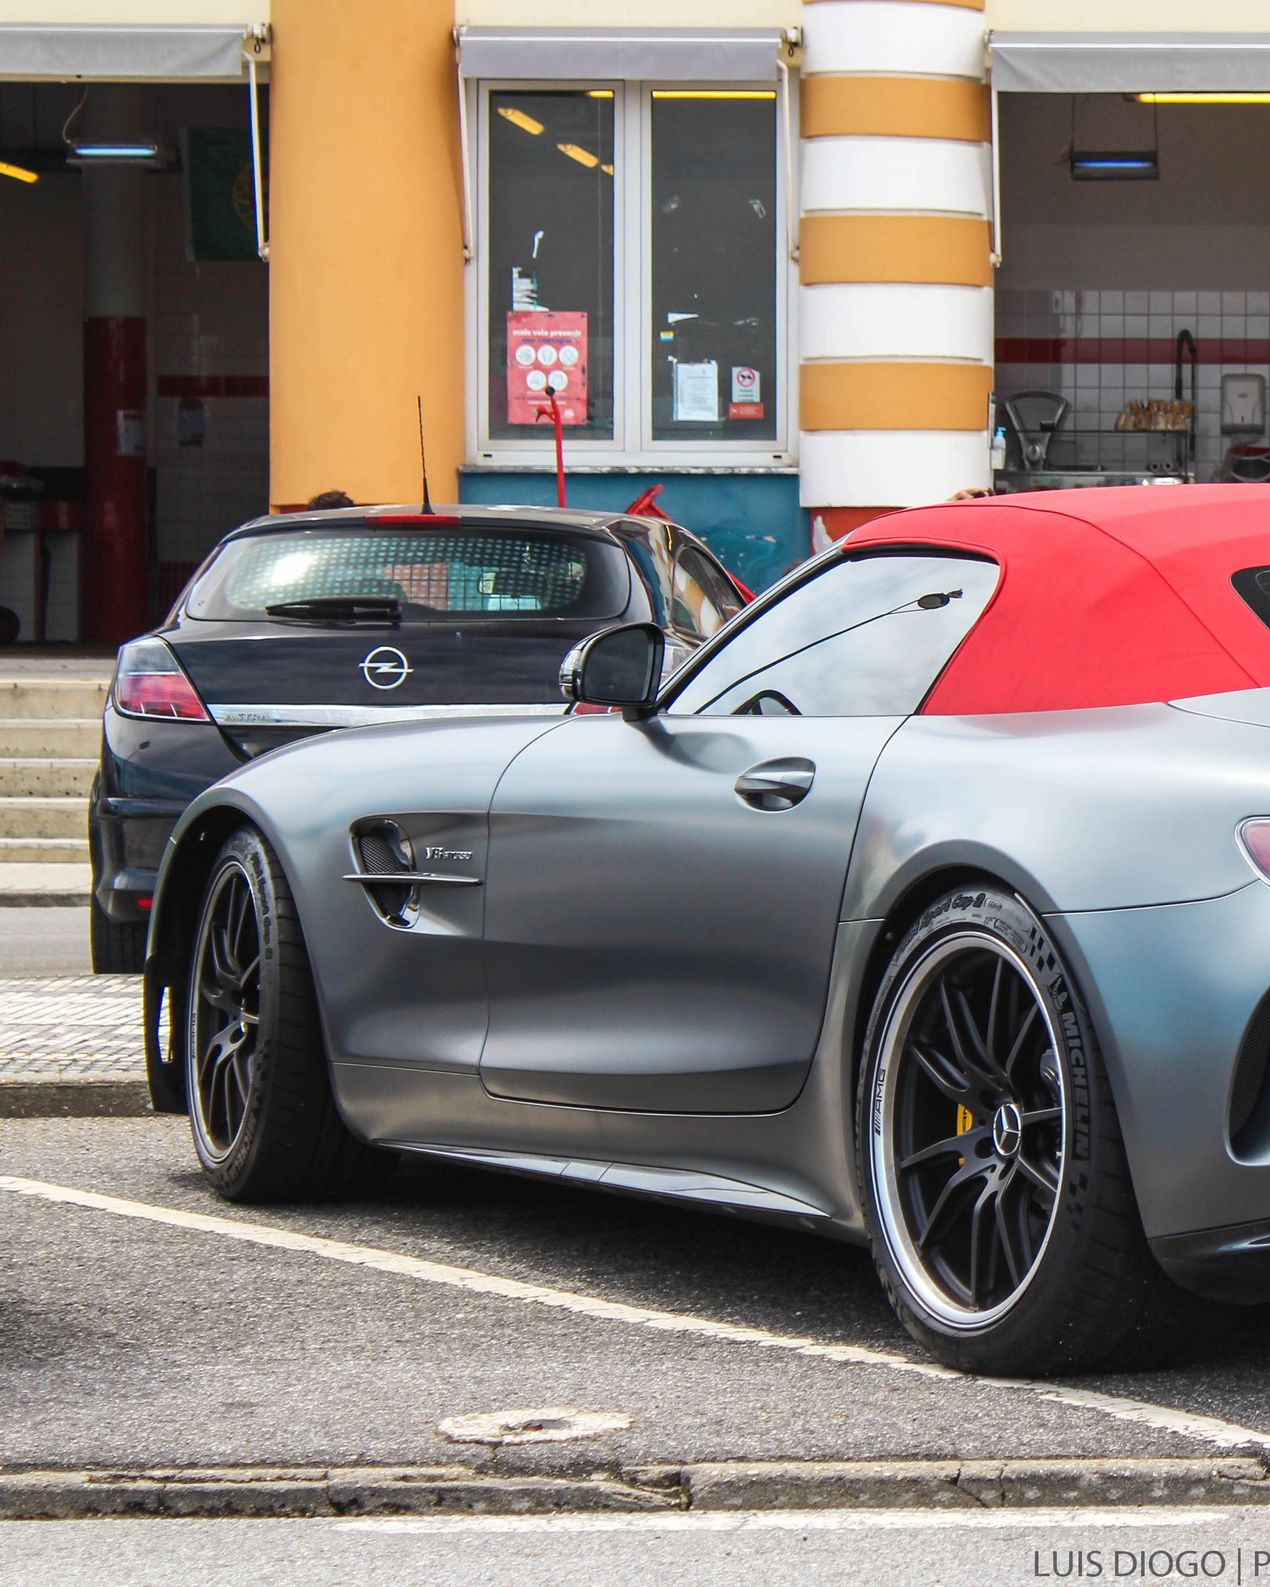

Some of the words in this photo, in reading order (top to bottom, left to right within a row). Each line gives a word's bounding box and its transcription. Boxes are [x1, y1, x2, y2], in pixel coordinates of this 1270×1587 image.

[225, 713, 270, 721] ASTRA
[952, 893, 974, 911] Cup
[973, 893, 986, 908] 2
[1062, 1011, 1089, 1160] MICHELIN
